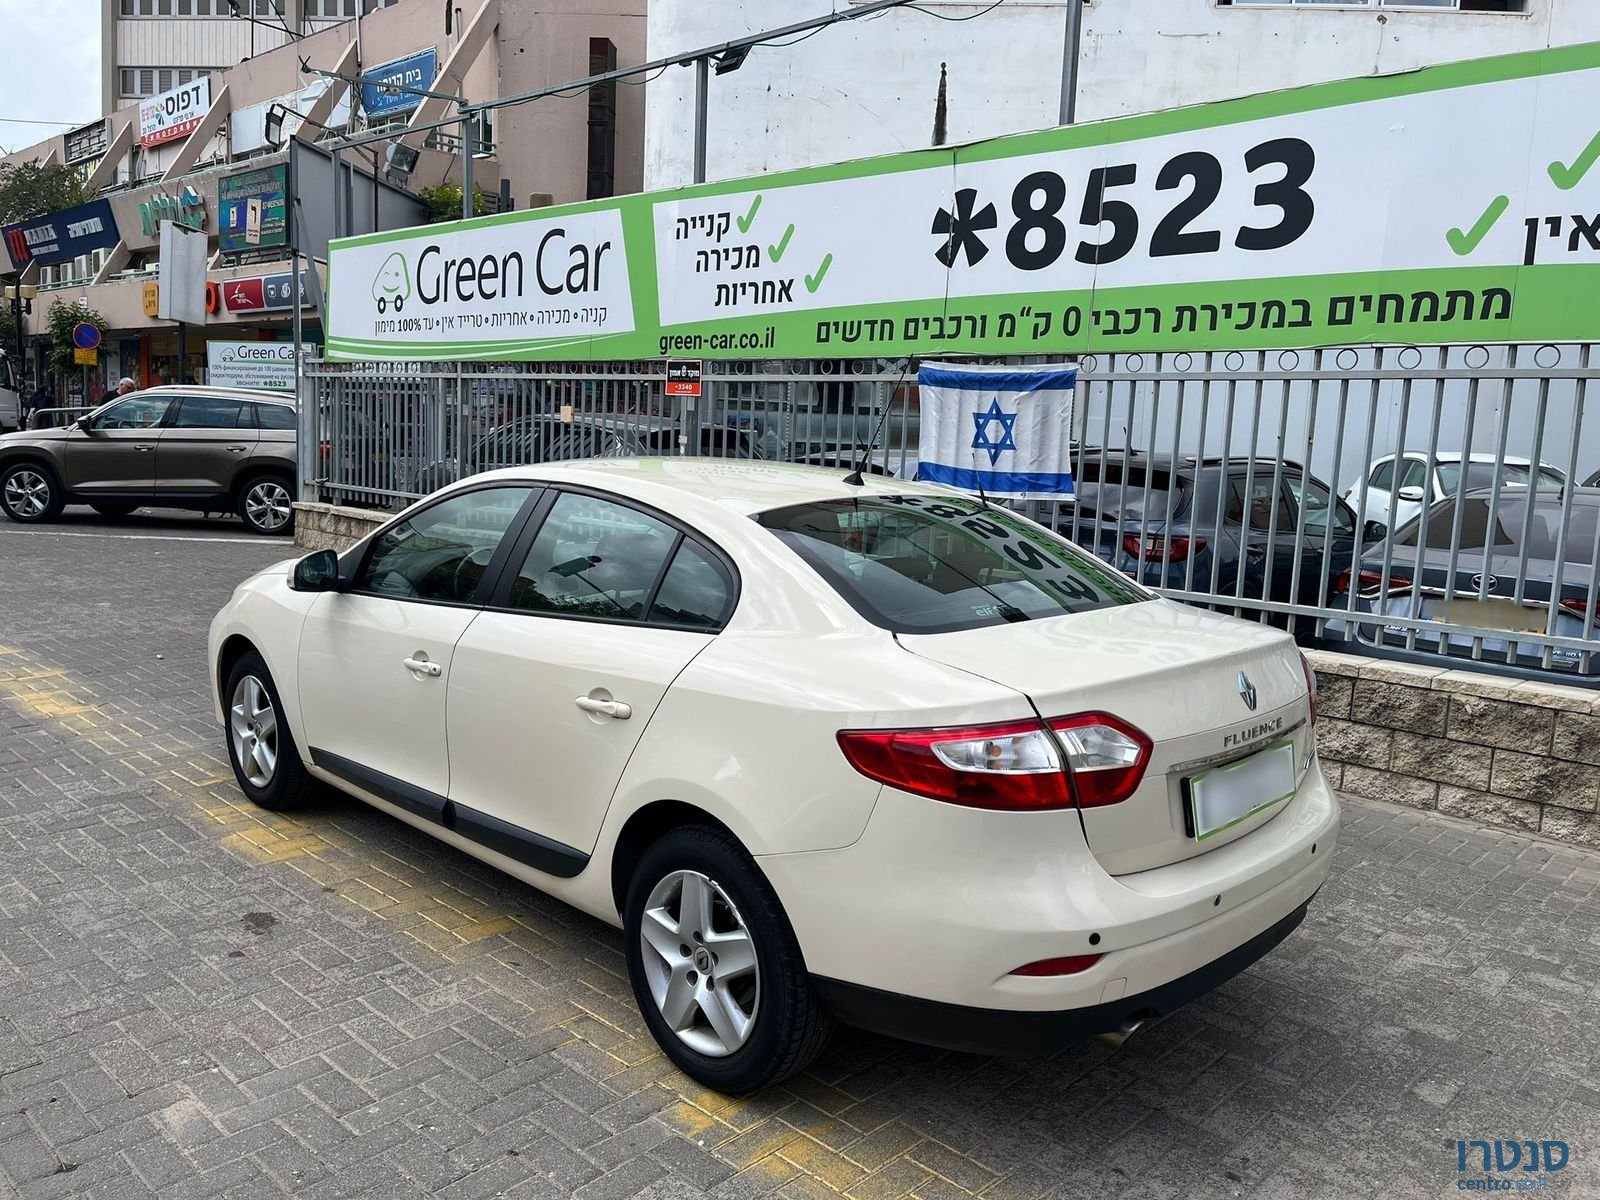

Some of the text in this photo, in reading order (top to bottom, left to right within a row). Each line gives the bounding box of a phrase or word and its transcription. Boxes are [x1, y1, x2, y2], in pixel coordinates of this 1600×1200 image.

[405, 68, 422, 84] בית
[164, 85, 201, 116] דפוס
[675, 212, 731, 243] קנייה
[416, 228, 611, 305] Green Car
[695, 244, 761, 273] מכירה
[714, 278, 795, 307] אחריות
[1327, 287, 1513, 327] מתמחים
[375, 307, 607, 336] קניה מכירה אחריות טרייד אין עד 100% מימון
[903, 314, 988, 341] ורכבים
[1062, 305, 1082, 337] 0
[1091, 307, 1162, 336] רכבי
[1171, 299, 1313, 333] במכירת
[659, 326, 776, 355] green-car.co.il
[816, 319, 895, 343] חדשים
[238, 346, 295, 359] Green Ca
[1223, 716, 1283, 748] FLUENCE
